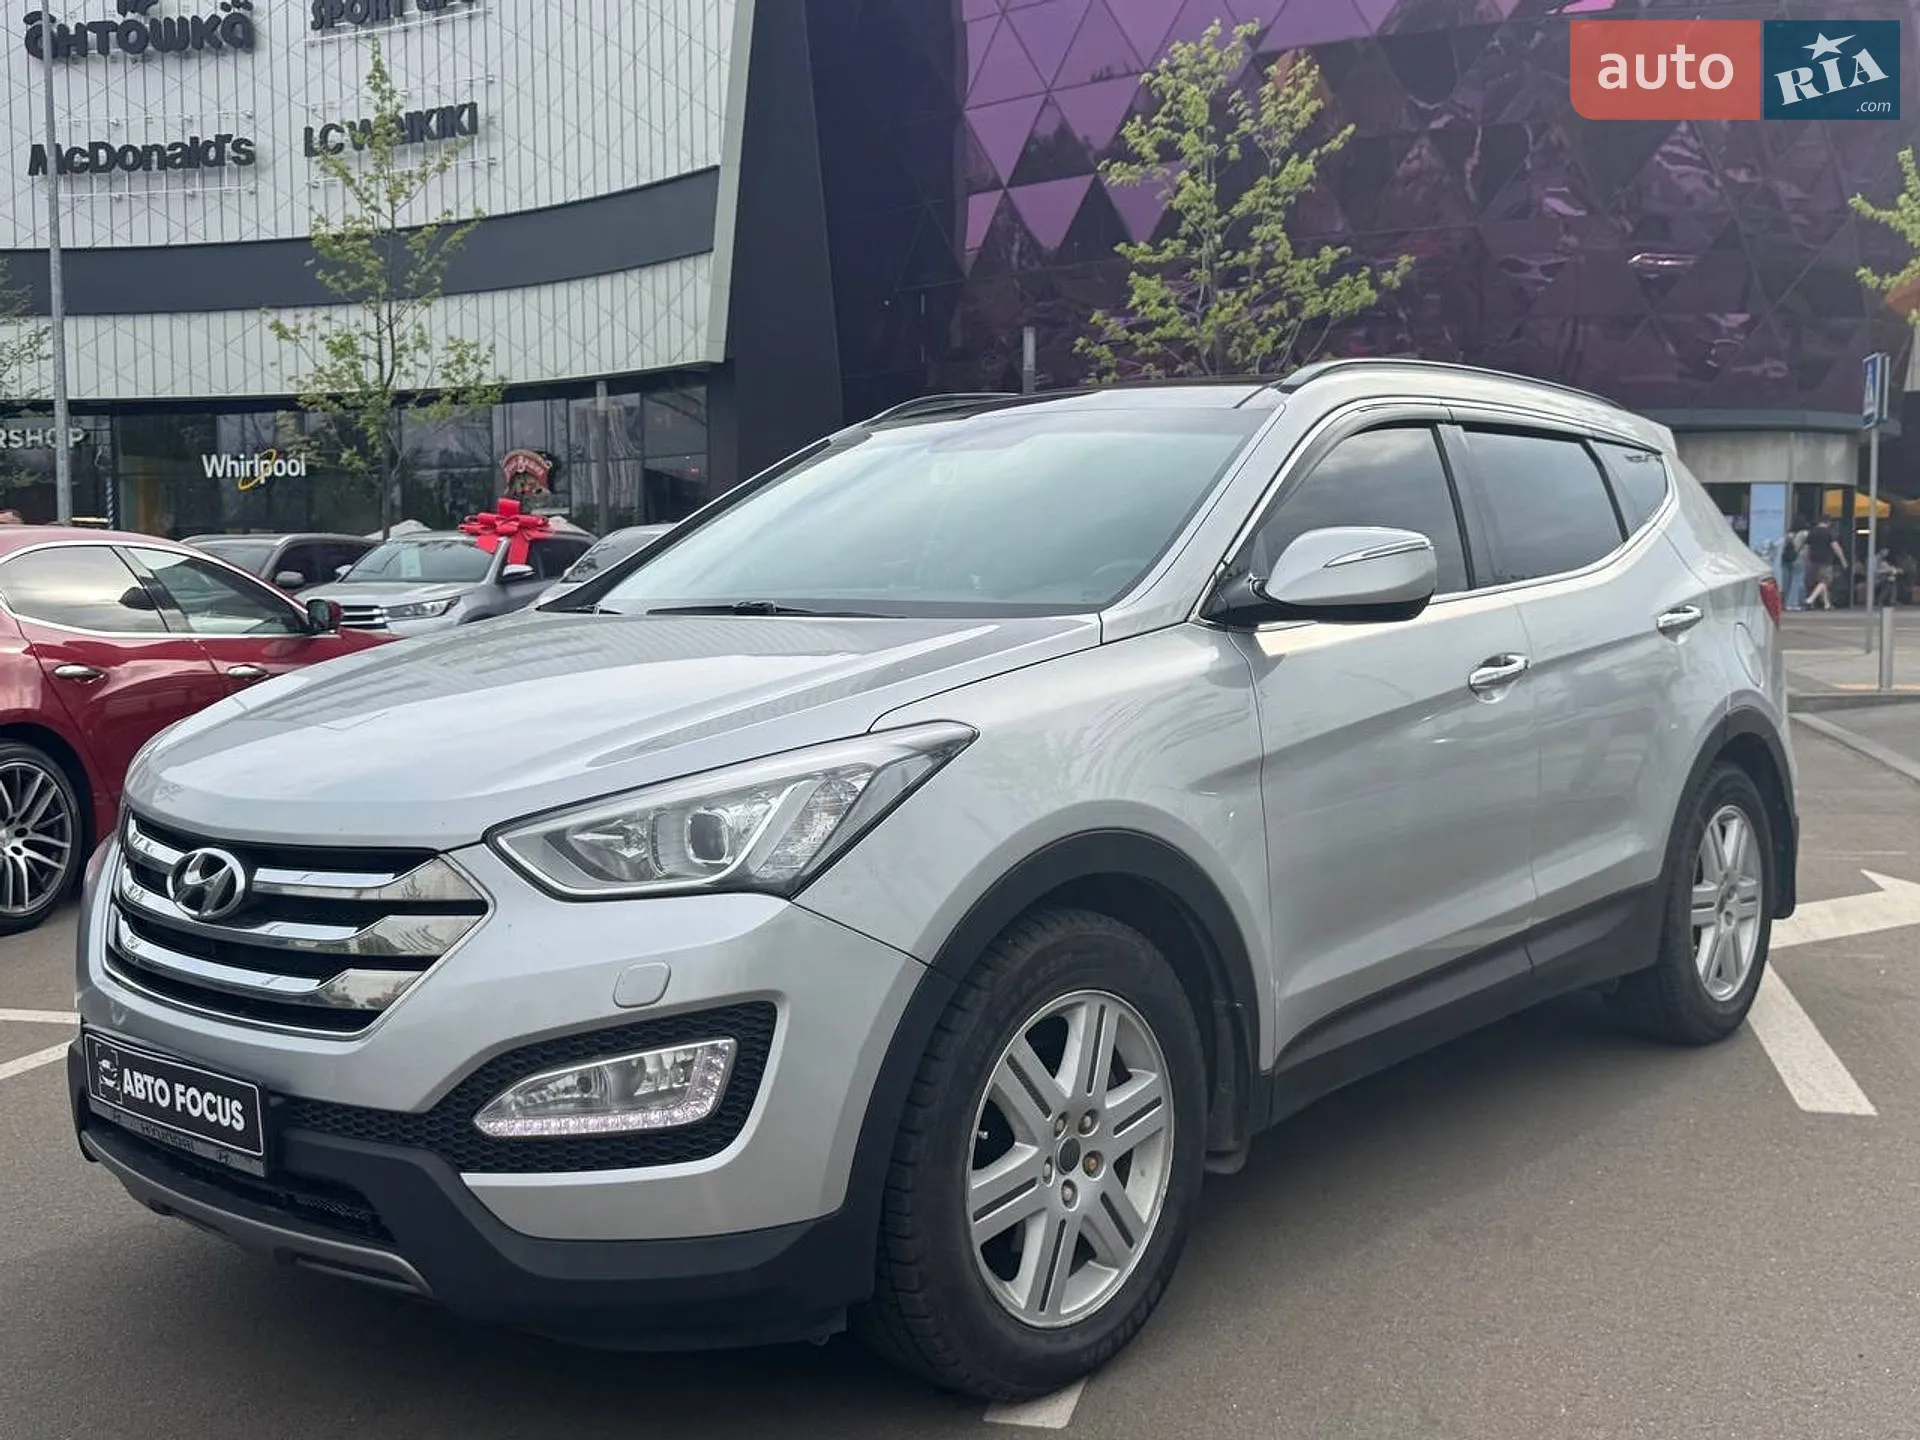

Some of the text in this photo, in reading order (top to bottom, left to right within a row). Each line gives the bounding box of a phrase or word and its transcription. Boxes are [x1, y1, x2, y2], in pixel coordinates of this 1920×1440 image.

[304, 102, 478, 157] LC WIKIKI
[28, 133, 256, 176] McDonald's
[202, 453, 306, 484] Whirlpool
[174, 1083, 246, 1132] FOCUS
